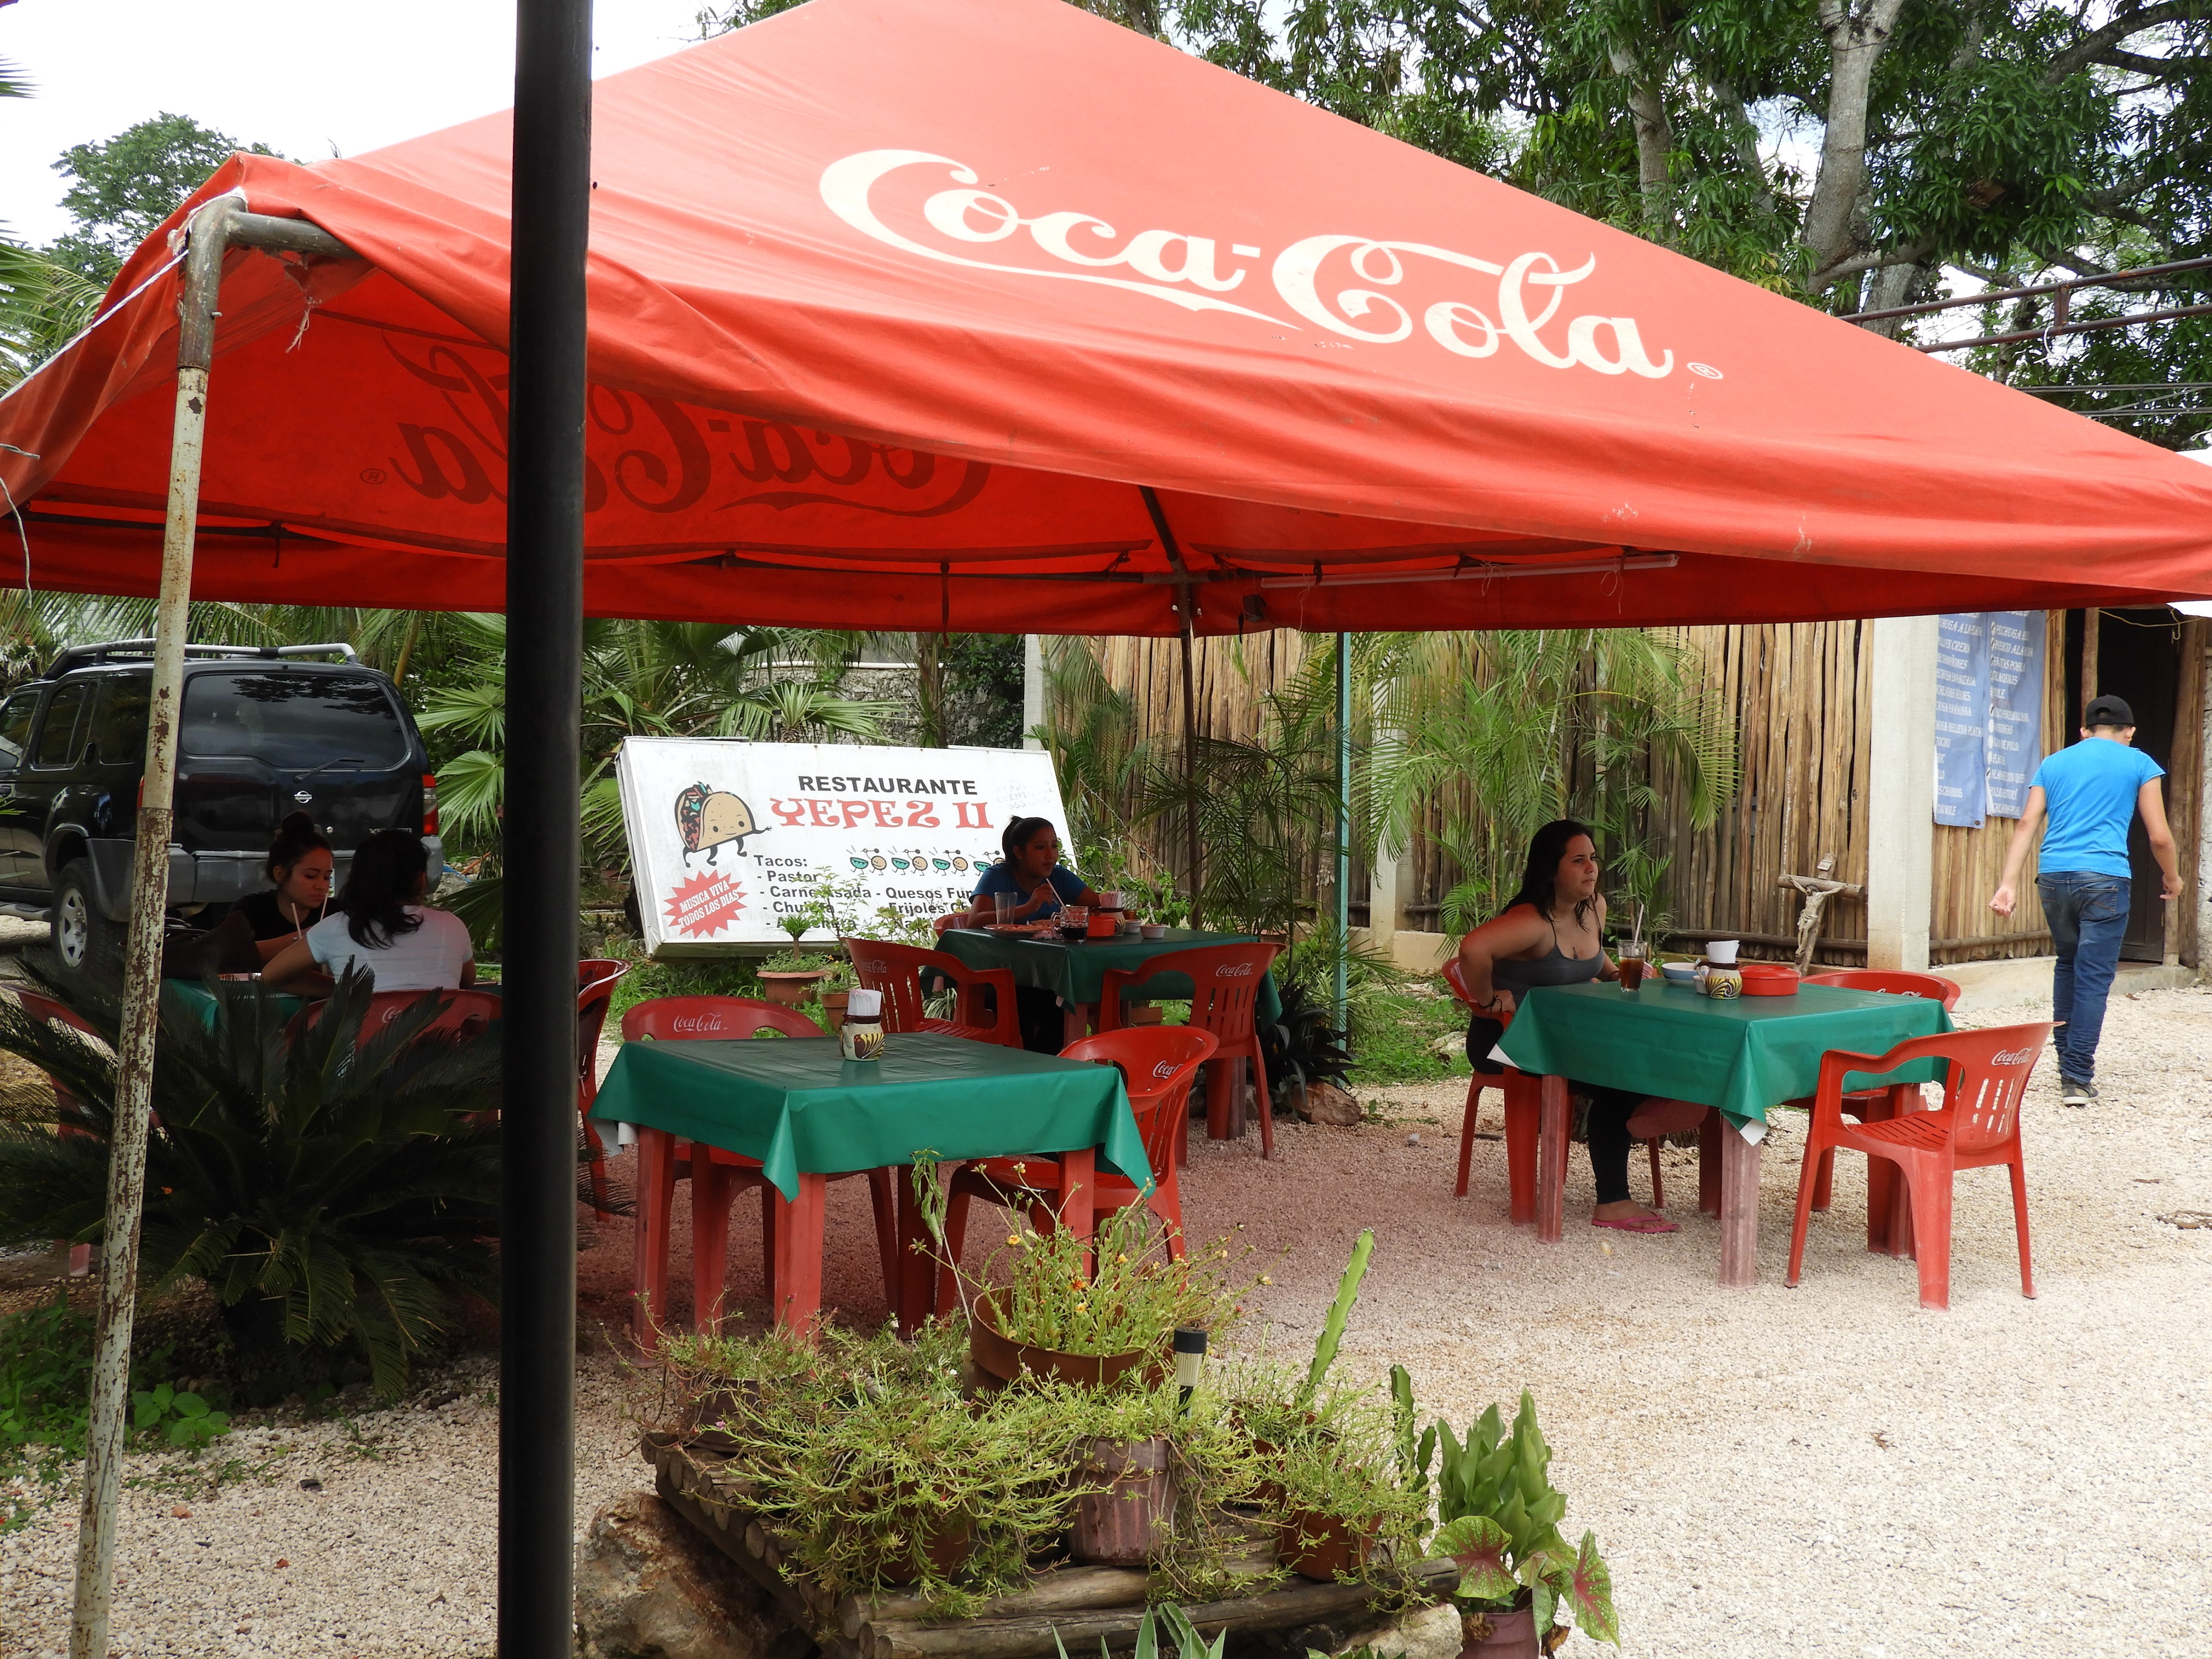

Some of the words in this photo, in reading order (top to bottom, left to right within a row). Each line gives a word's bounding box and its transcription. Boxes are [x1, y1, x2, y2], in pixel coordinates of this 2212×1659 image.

[798, 776, 978, 795] RESTAURANTE
[770, 798, 941, 829] YEPEZ
[753, 855, 808, 867] Tacos:
[767, 870, 818, 882] Pastor
[679, 890, 710, 913] MUSICA
[709, 880, 729, 897] VIVA
[770, 886, 817, 898] Carne
[886, 887, 942, 899] Quesos
[947, 888, 973, 899] Fun
[678, 907, 705, 928] TODOS
[704, 899, 720, 915] LOS
[720, 889, 740, 907] DIAS
